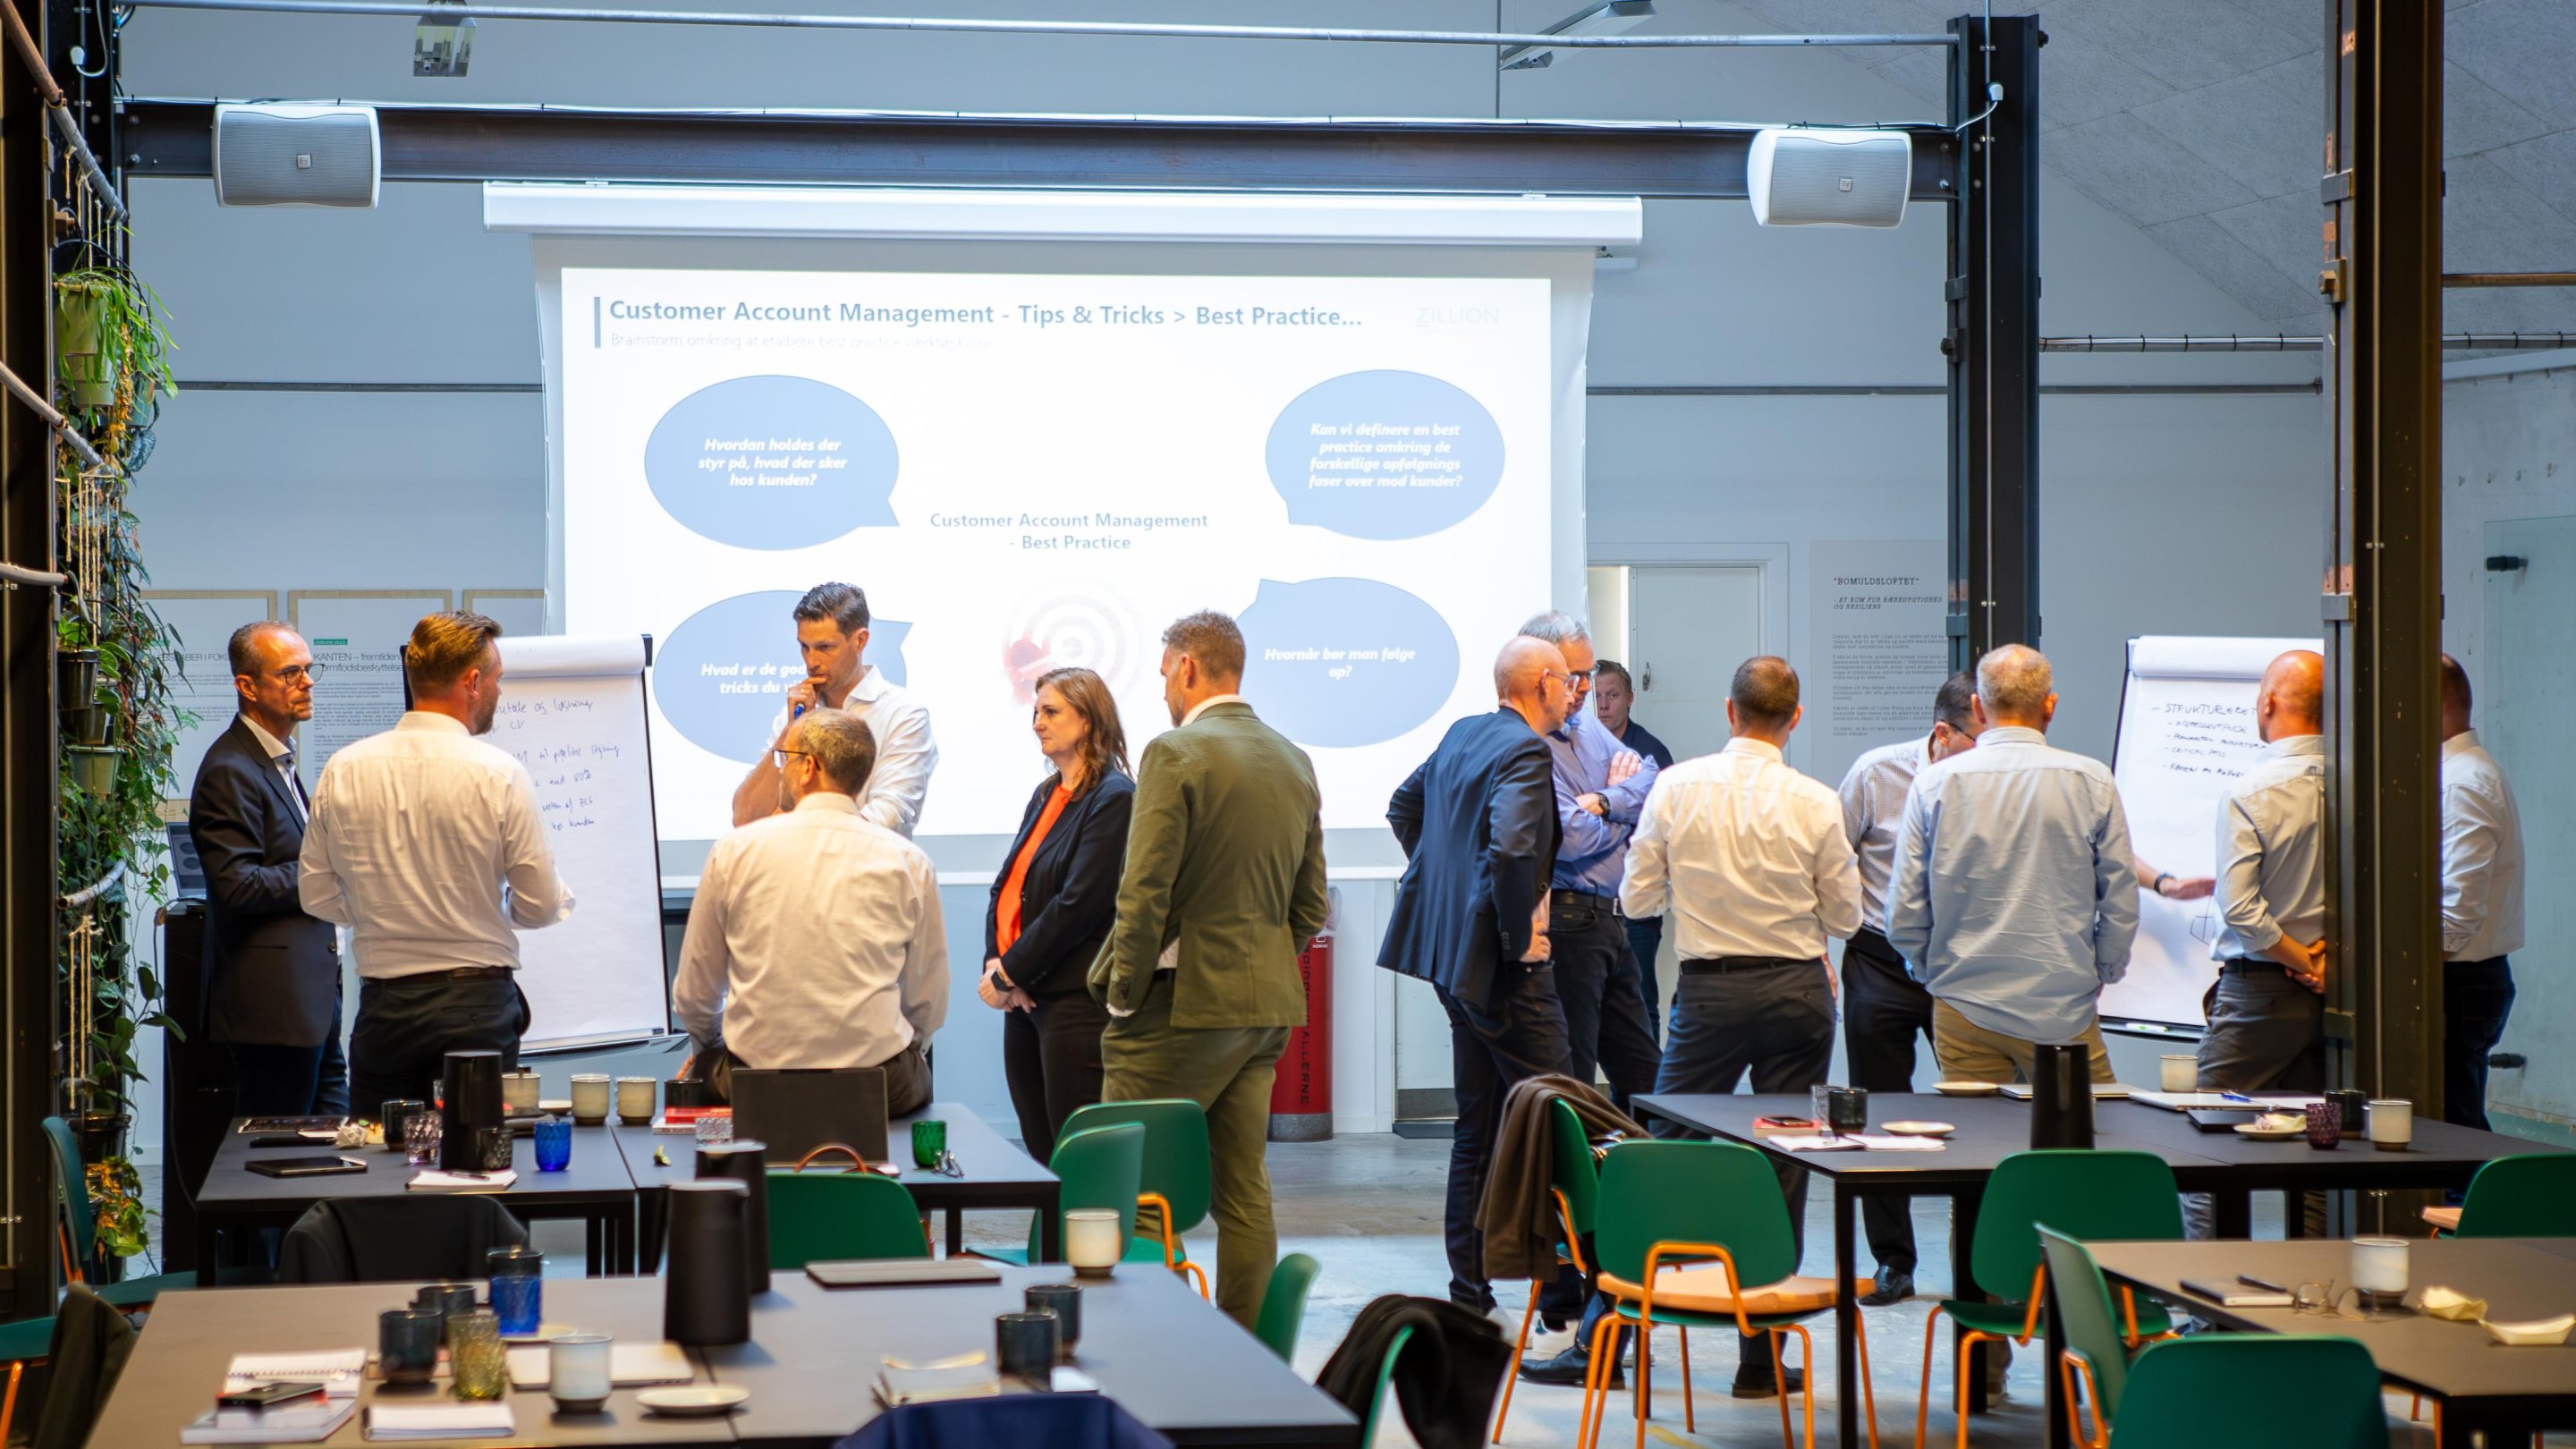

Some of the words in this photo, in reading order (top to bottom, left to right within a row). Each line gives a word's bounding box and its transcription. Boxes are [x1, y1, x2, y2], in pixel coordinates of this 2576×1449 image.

[609, 300, 726, 320] Customer
[733, 301, 832, 321] Account
[840, 302, 994, 328] Management
[1018, 304, 1064, 329] Tips
[1072, 305, 1092, 324] &
[1099, 305, 1165, 325] Tricks
[1174, 310, 1186, 323] >
[1197, 306, 1244, 325] Best
[1252, 306, 1362, 326] Practice...
[1416, 307, 1500, 324] ZILLION
[610, 333, 683, 347] Brainstorm
[686, 334, 741, 350] omkring
[746, 335, 758, 347] at
[818, 335, 846, 348] best
[850, 335, 902, 351] practice
[1309, 422, 1337, 436] Kan
[1340, 423, 1353, 436] vi
[1355, 422, 1411, 438] definere
[1412, 426, 1431, 436] en
[1432, 422, 1461, 436] best
[704, 437, 766, 452] Hvordan
[768, 437, 815, 452] holdes
[817, 437, 843, 452] der
[1318, 440, 1374, 456] practice
[1375, 440, 1432, 455] omkring
[1434, 440, 1452, 453] de
[698, 457, 726, 472] styr
[727, 454, 750, 472] på,
[753, 455, 790, 470] hvad
[791, 455, 817, 470] der
[818, 455, 848, 470] sker
[1309, 457, 1381, 473] forskellige
[1382, 457, 1462, 472] opfølgnings
[727, 472, 755, 487] hos
[757, 472, 818, 487] kunden?
[1308, 474, 1343, 490] faser
[1344, 478, 1375, 487] over
[1377, 475, 1408, 487] mod
[1409, 474, 1463, 487] kunder?
[930, 513, 1013, 527] Customer
[1019, 513, 1089, 527] Account
[1096, 513, 1208, 531] Management
[1022, 535, 1057, 549] Best
[1063, 535, 1131, 549] Practice
[314, 652, 352, 662] KANTEN
[1264, 647, 1321, 661] Hvornår
[1322, 647, 1347, 661] bør
[1348, 650, 1379, 661] man
[1381, 647, 1417, 663] følge
[700, 662, 740, 676] Hvad
[741, 665, 758, 676] er
[758, 662, 778, 676] de
[779, 662, 807, 679] god
[1328, 665, 1353, 681] op?
[719, 681, 759, 694] tricks
[761, 681, 781, 694] du
